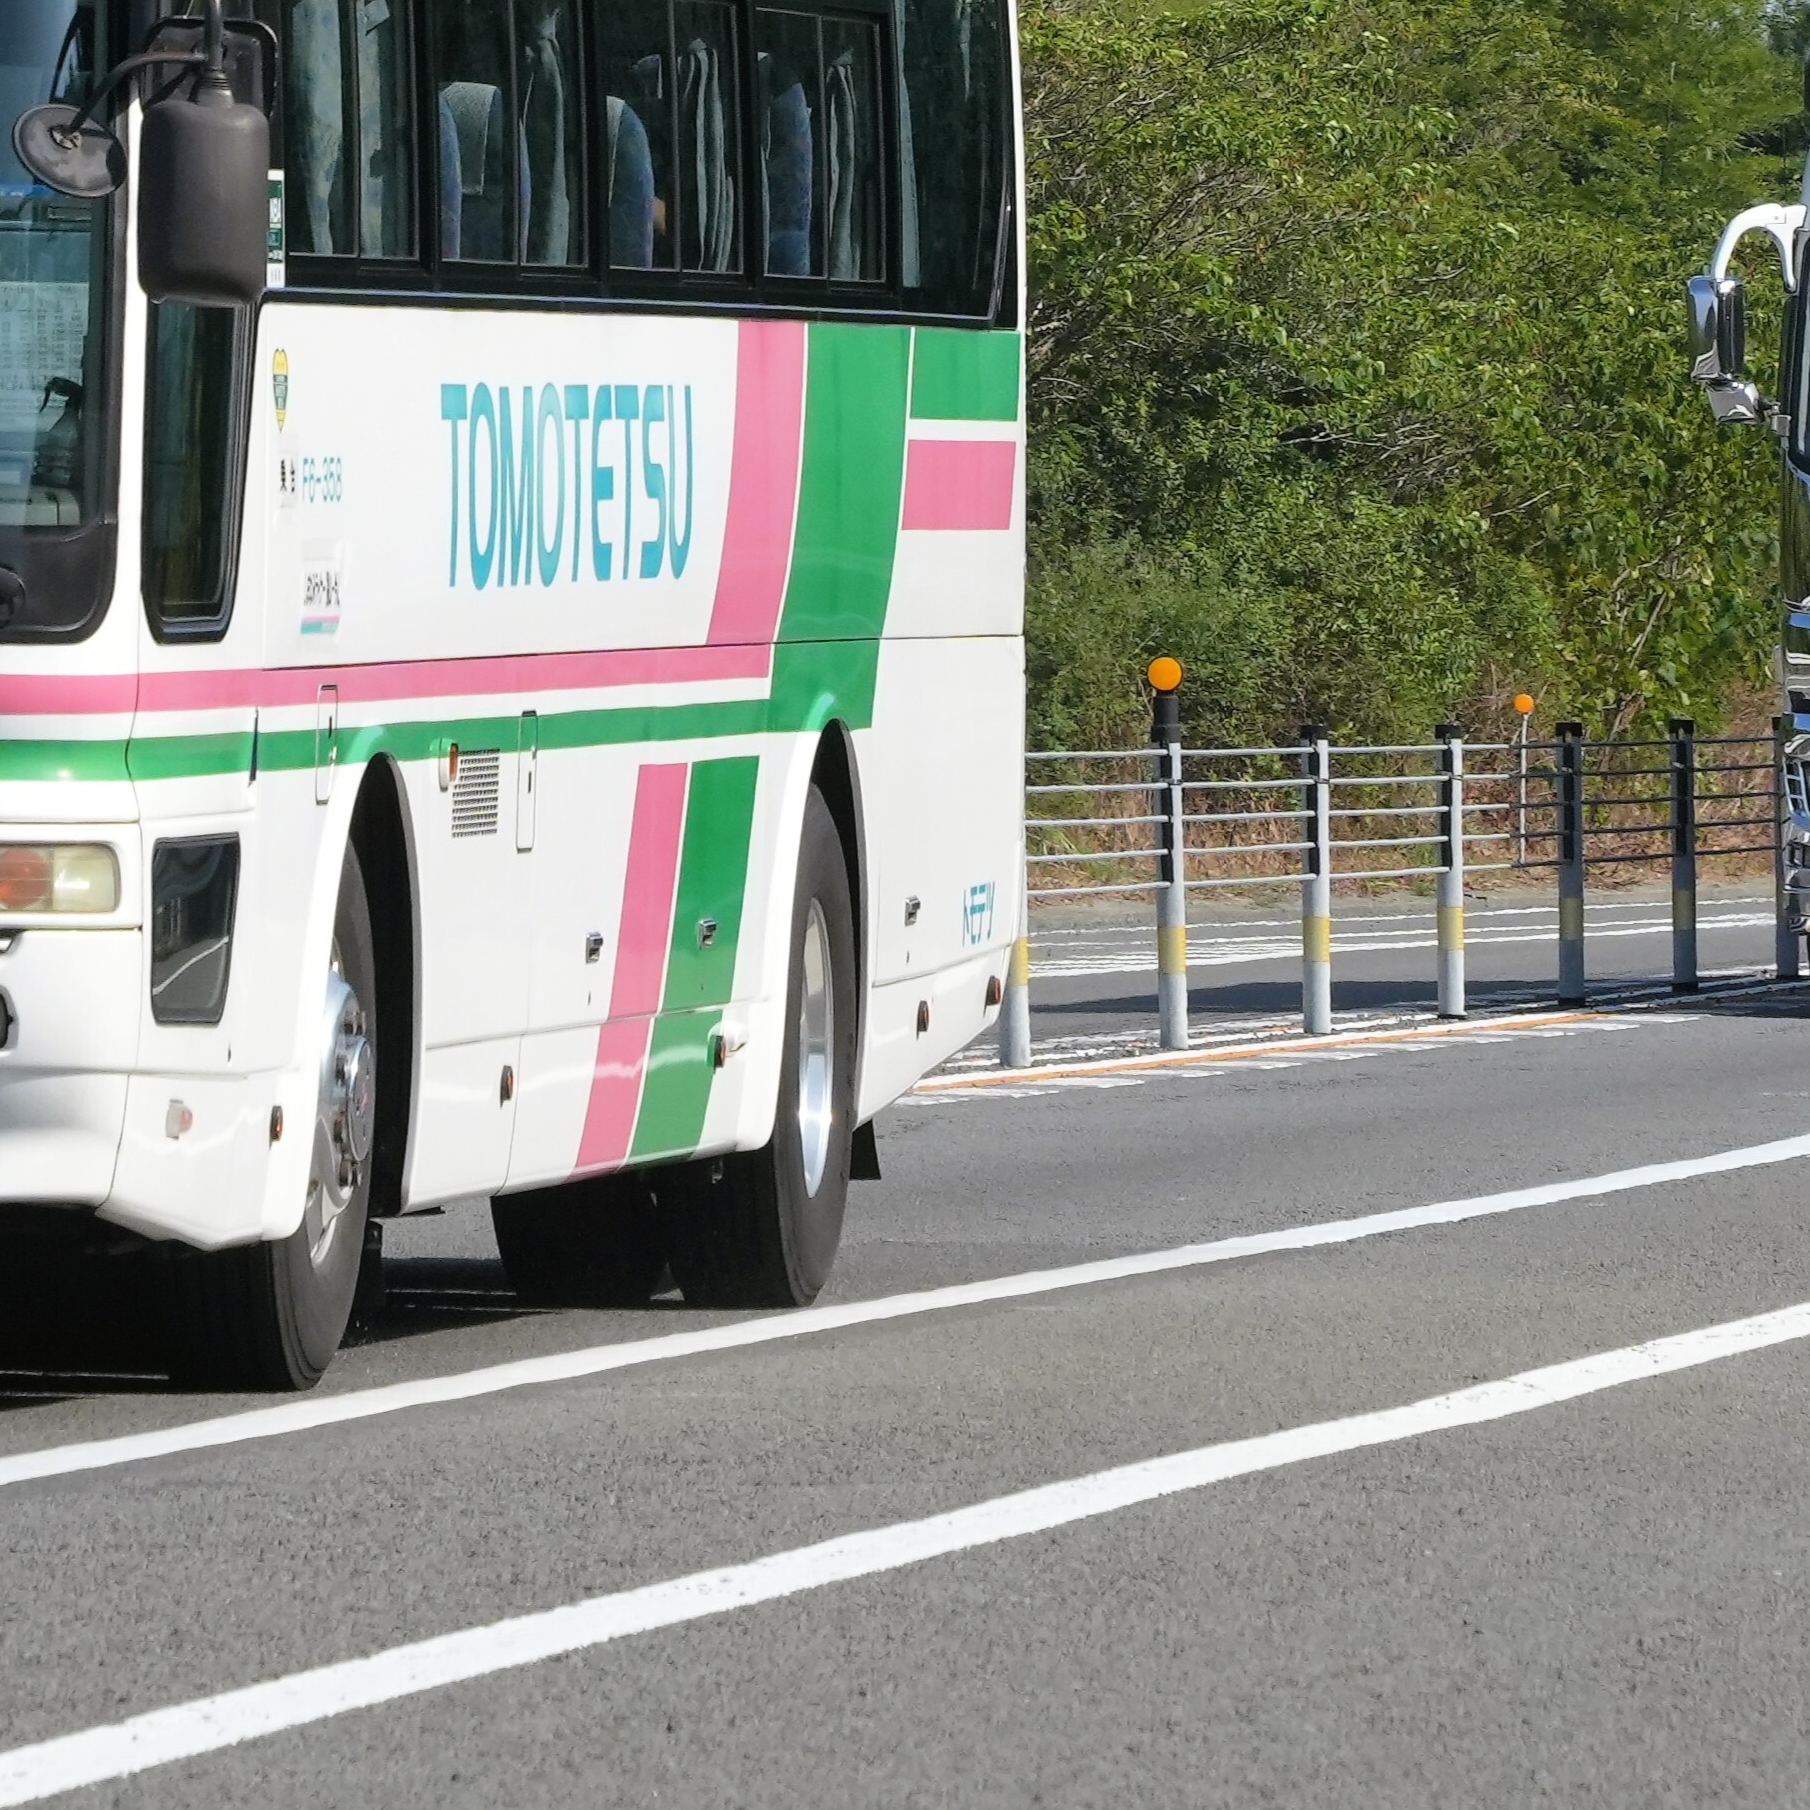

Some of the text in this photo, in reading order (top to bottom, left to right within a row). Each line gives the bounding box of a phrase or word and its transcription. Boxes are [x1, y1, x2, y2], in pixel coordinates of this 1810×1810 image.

[441, 382, 693, 590] TOMOTETSU
[961, 880, 996, 948] トモテツ
